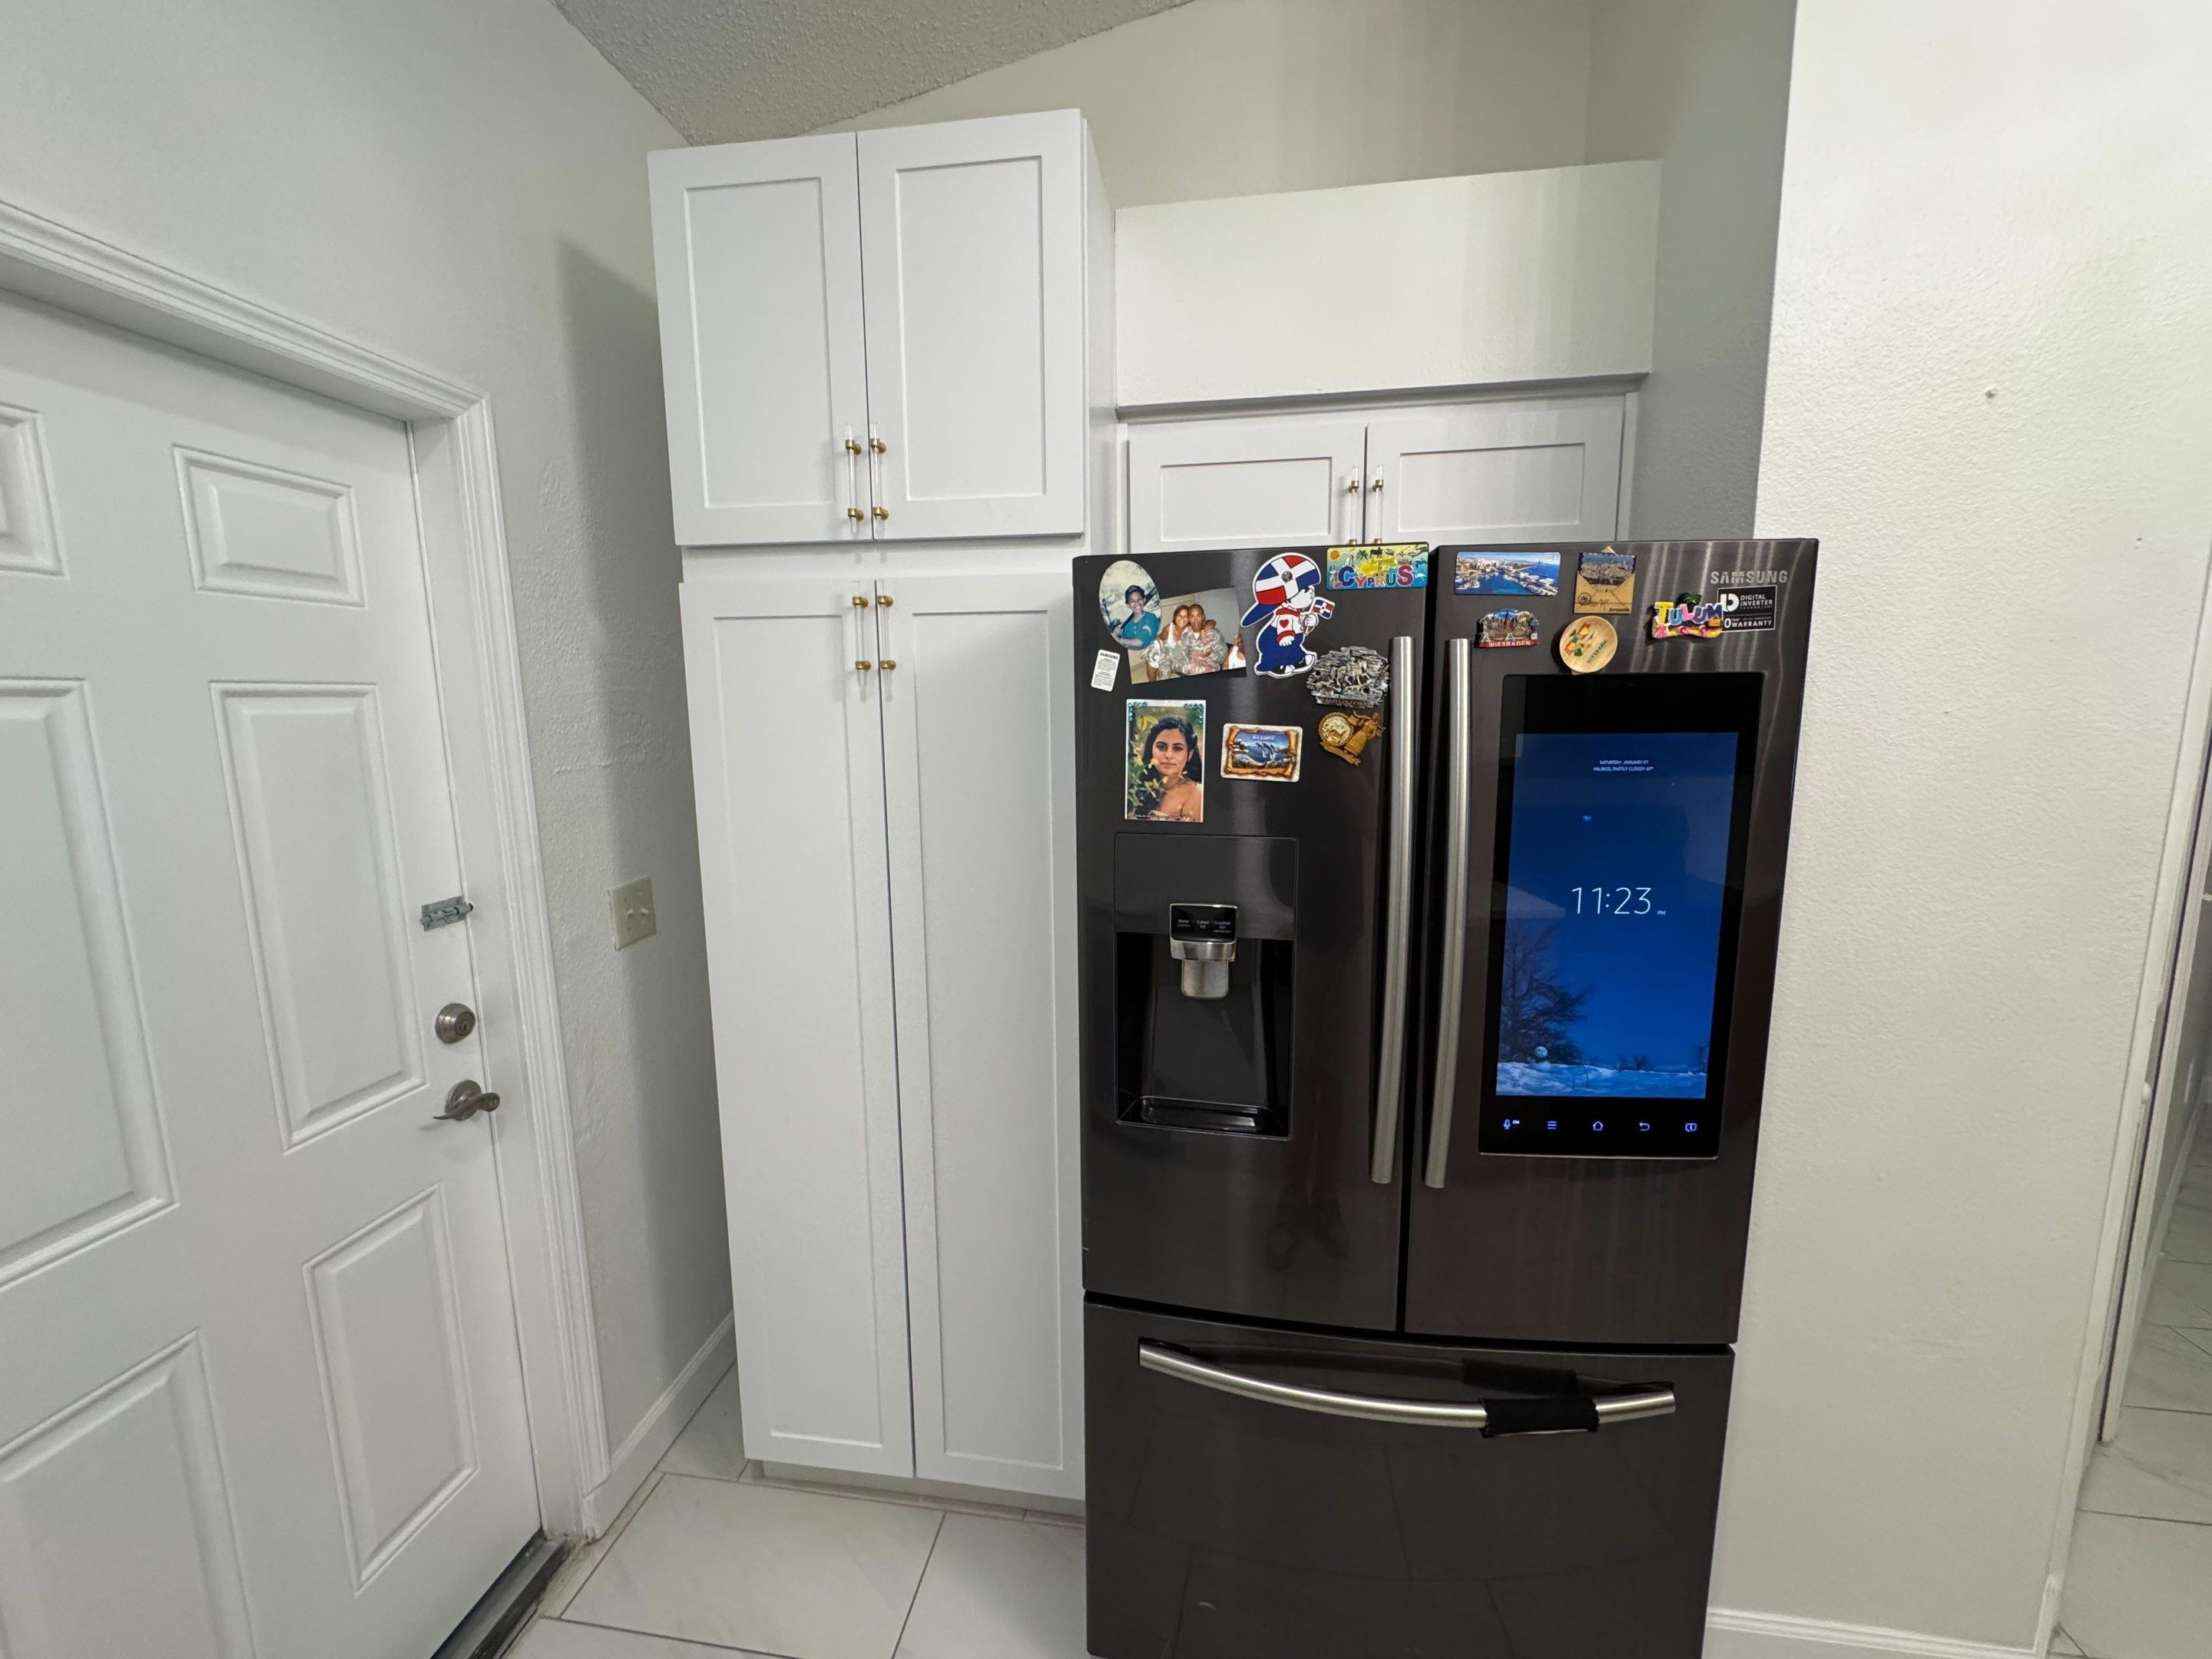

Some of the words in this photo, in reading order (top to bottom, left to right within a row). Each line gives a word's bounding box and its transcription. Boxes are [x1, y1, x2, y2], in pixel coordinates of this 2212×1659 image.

[1338, 565, 1414, 588] CYPRUS
[1710, 570, 1788, 584] SAMSUNG
[1654, 601, 1724, 626] TULUM
[1731, 620, 1773, 628] WARRANTY
[1571, 887, 1651, 915] 11:23
